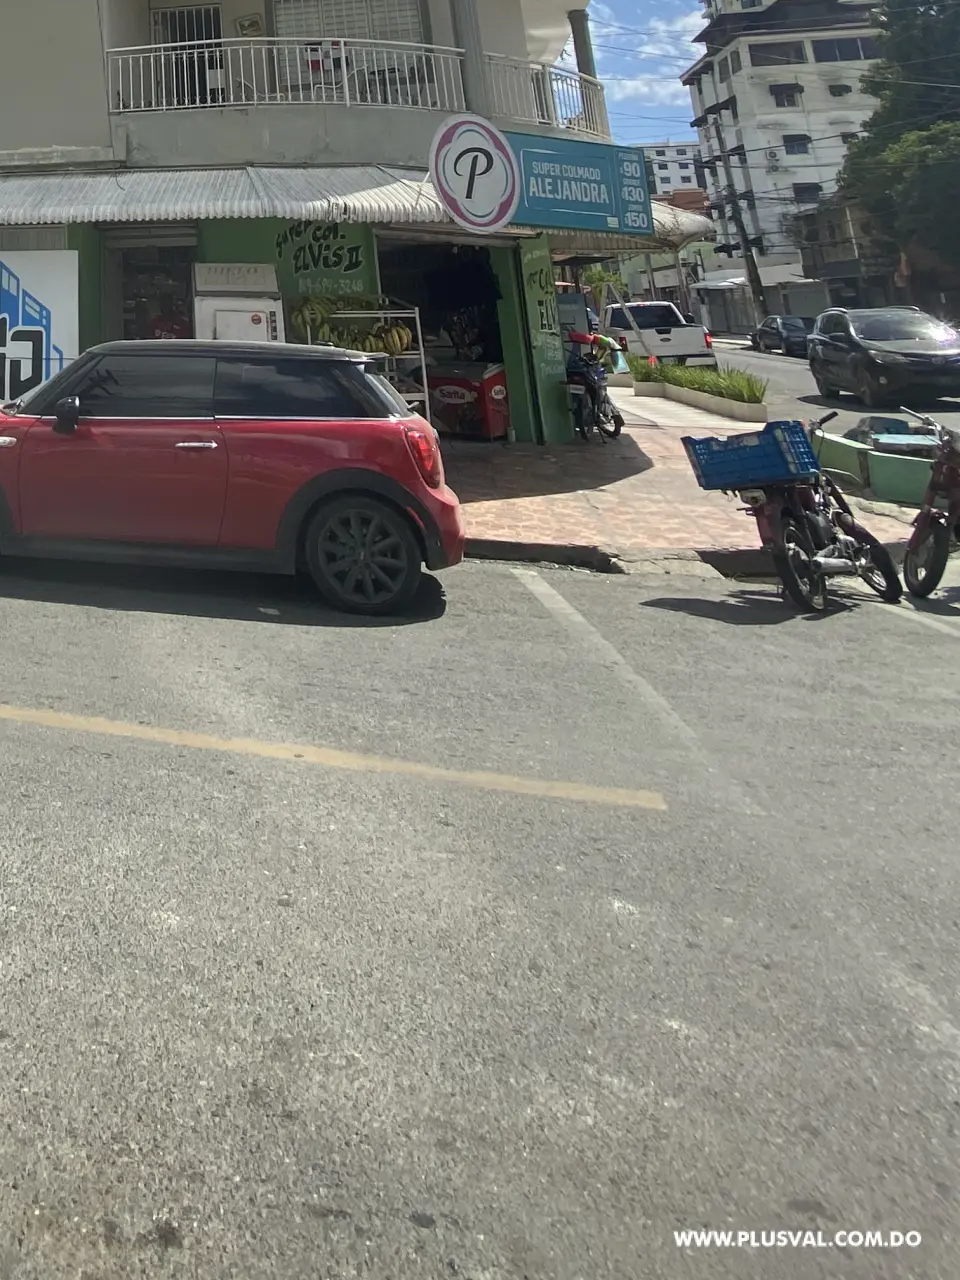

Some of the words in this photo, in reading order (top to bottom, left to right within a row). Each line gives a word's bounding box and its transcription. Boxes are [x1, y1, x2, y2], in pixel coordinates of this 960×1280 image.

[454, 147, 493, 199] P
[532, 161, 560, 176] SUPER
[562, 165, 601, 180] COLMADO
[529, 177, 609, 204] ALEJANDRA
